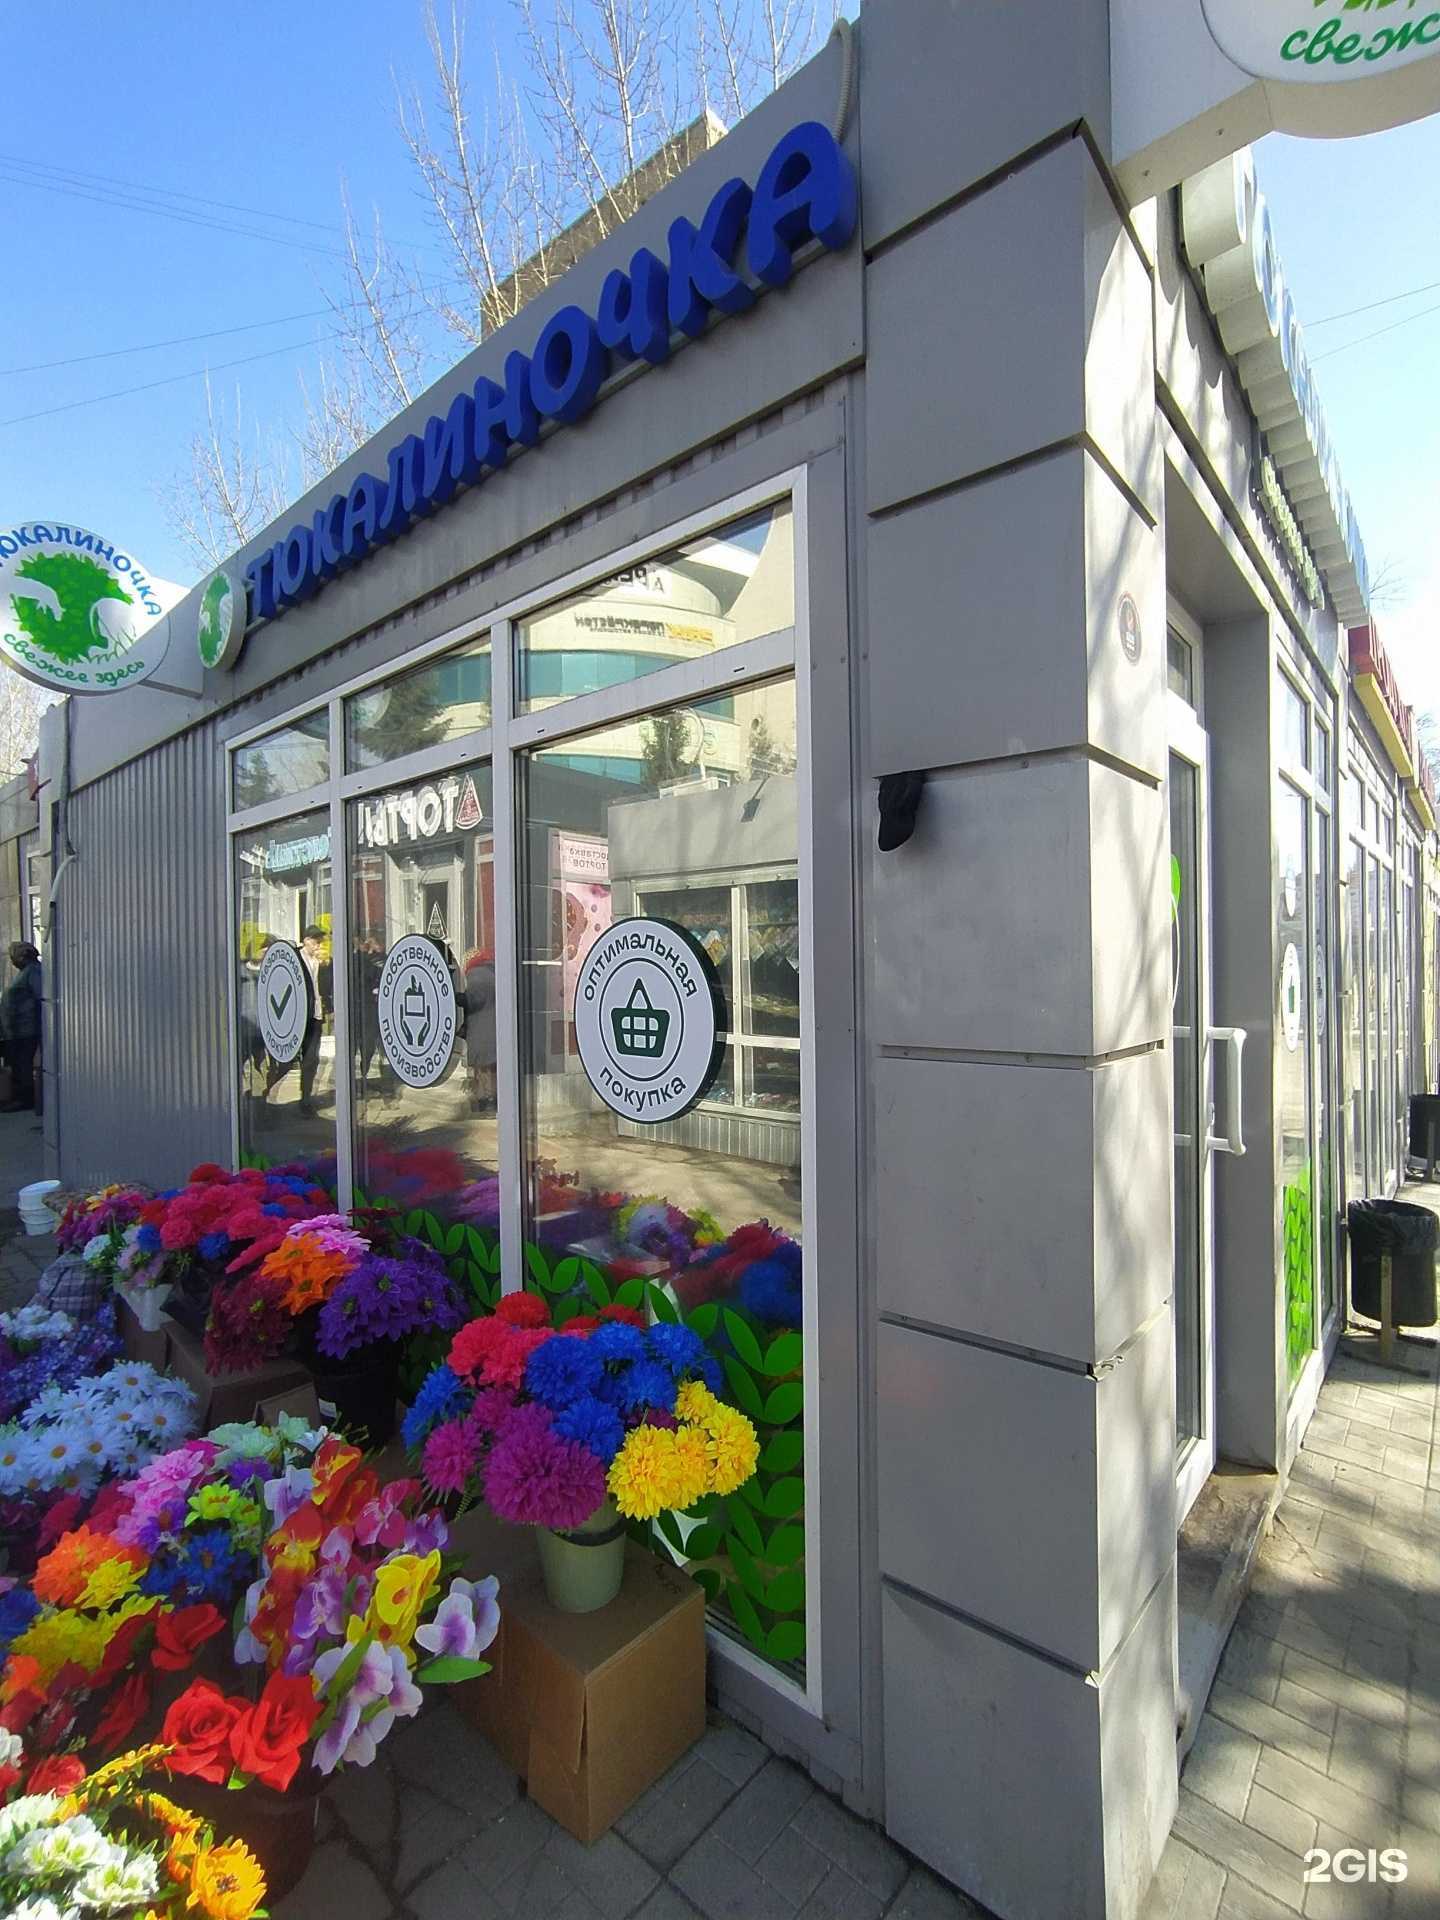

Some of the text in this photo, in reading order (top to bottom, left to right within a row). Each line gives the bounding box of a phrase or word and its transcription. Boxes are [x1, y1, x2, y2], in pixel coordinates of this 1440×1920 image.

[246, 121, 857, 618] ТЮКАЛИНОЧКА
[0, 524, 162, 616] ЮКАЛИНОЧКА
[4, 633, 145, 686] свежее здесь
[383, 945, 449, 998] собственное
[584, 933, 697, 1001] оптимальная
[382, 1016, 452, 1079] производство
[600, 1067, 686, 1112] покупка
